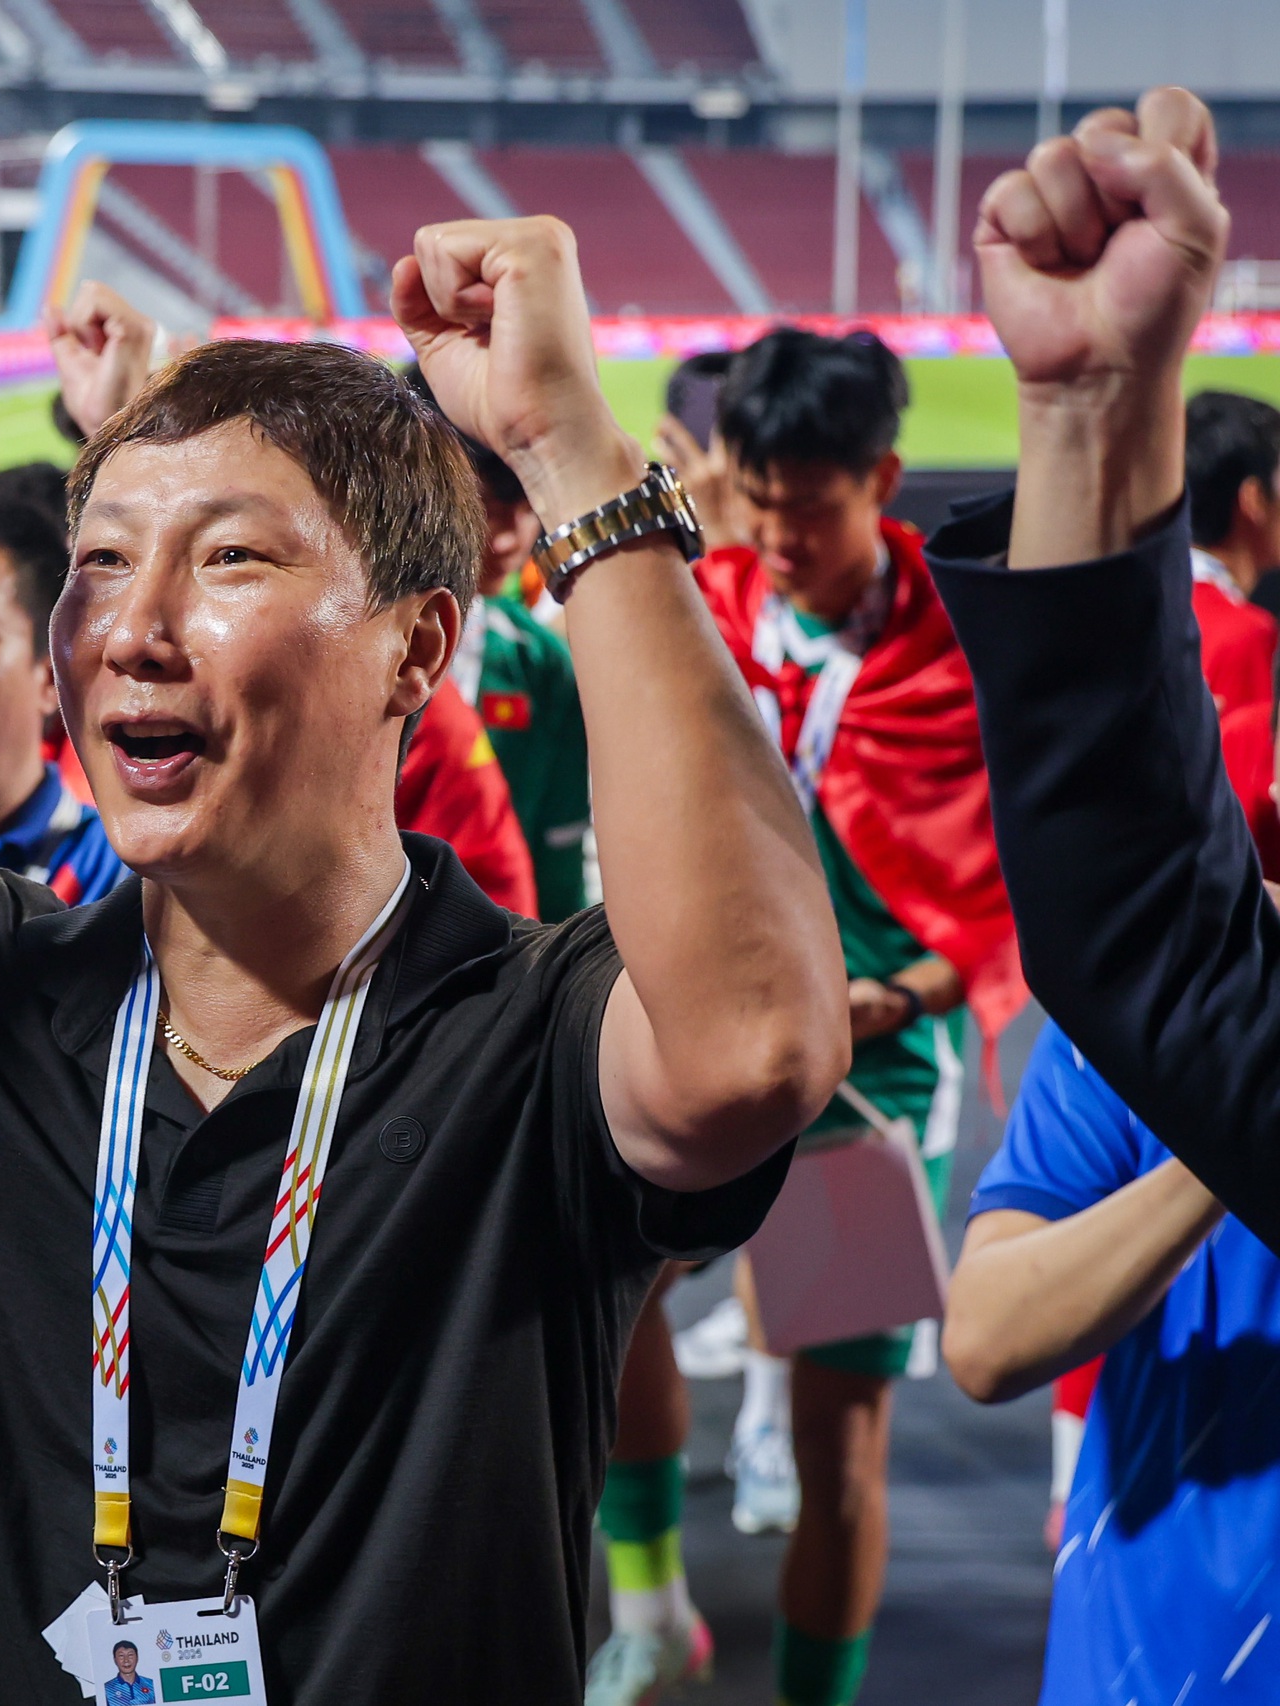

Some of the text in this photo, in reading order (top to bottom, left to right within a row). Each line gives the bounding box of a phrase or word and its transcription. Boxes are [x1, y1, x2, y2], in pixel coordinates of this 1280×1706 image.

[232, 1451, 266, 1465] THAILAND
[94, 1464, 127, 1473] THAILAND
[242, 1461, 255, 1469] 2025
[176, 1631, 239, 1649] THAILAND
[177, 1648, 202, 1660] 2025
[181, 1672, 229, 1693] F-02
